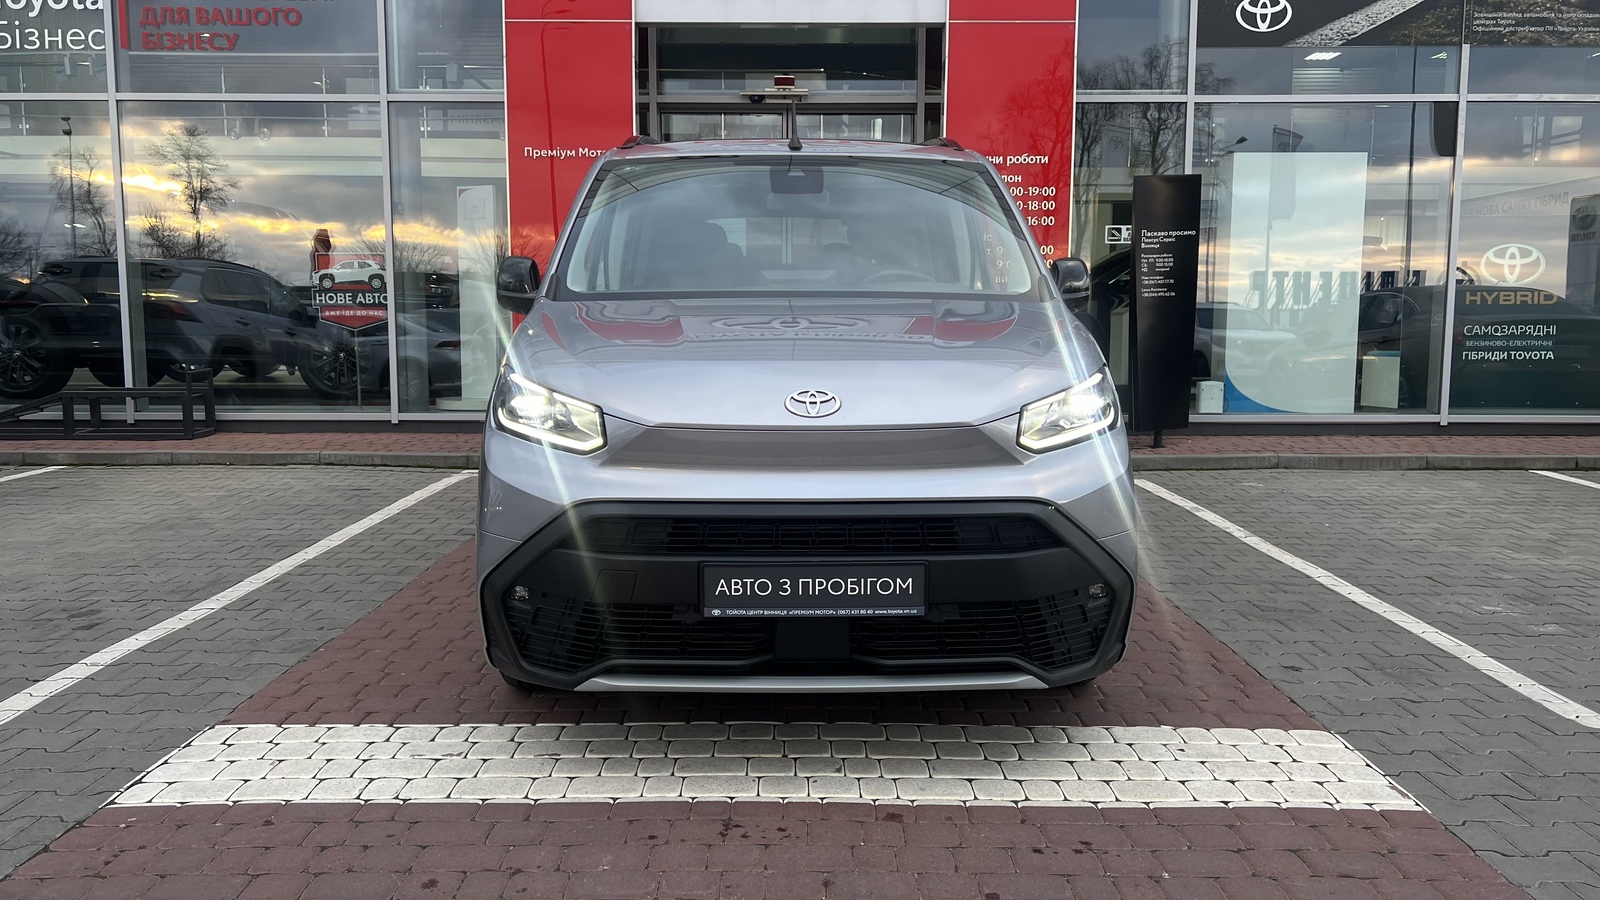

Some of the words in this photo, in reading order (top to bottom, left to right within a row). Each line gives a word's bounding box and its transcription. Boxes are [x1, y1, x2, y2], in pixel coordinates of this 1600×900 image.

[140, 6, 189, 28] ДЛЯ
[195, 7, 302, 26] ВАШОГО
[141, 32, 240, 50] БІЗНЕСУ
[524, 146, 576, 159] Преміум
[578, 147, 606, 157] Мот
[1006, 153, 1049, 166] роботи
[1010, 186, 1056, 197] 00-19:00
[1016, 200, 1056, 211] 0-18:00
[316, 293, 353, 304] НОВЕ
[356, 293, 388, 304] АВТО
[1465, 291, 1558, 305] HYBRID
[342, 309, 354, 317] ЇДЕ
[1463, 325, 1557, 337] САМОЗАРЯДНІ
[1462, 351, 1507, 361] ГІБРИДИ
[1510, 351, 1554, 360] TOYOTA
[715, 578, 772, 596] АВТО
[778, 578, 791, 596] З
[799, 577, 913, 596] ПРОБІГОМ
